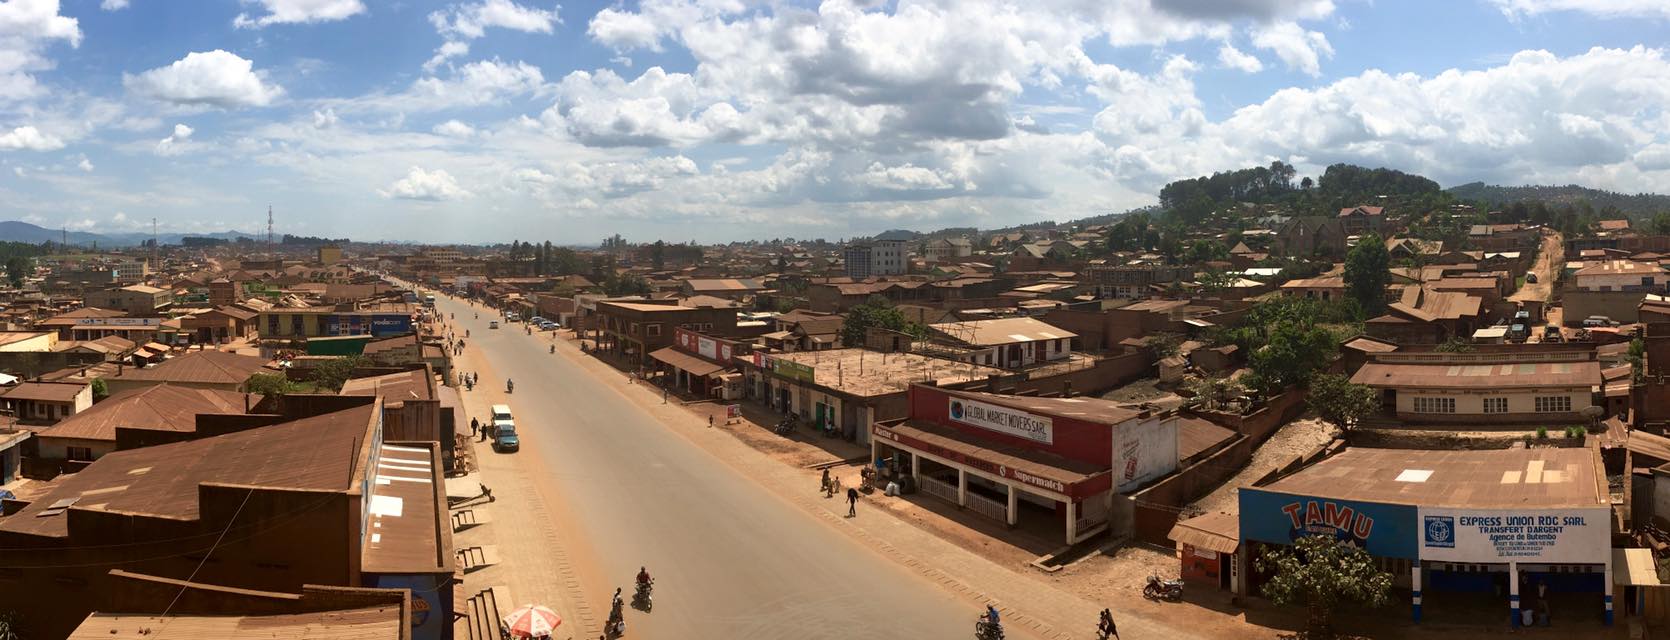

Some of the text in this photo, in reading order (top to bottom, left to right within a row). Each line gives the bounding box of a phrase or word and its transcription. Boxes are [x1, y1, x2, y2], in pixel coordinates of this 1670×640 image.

[967, 405, 1047, 435] GLOBAL MARKET MOVERS SARL
[1014, 469, 1064, 492] Supermatch
[1282, 501, 1374, 539] TAMU
[1459, 516, 1587, 526] EXPRESS UNION RDC SARL
[1479, 526, 1524, 534] TRANSFERT
[1489, 533, 1557, 542] Agence de Butembo
